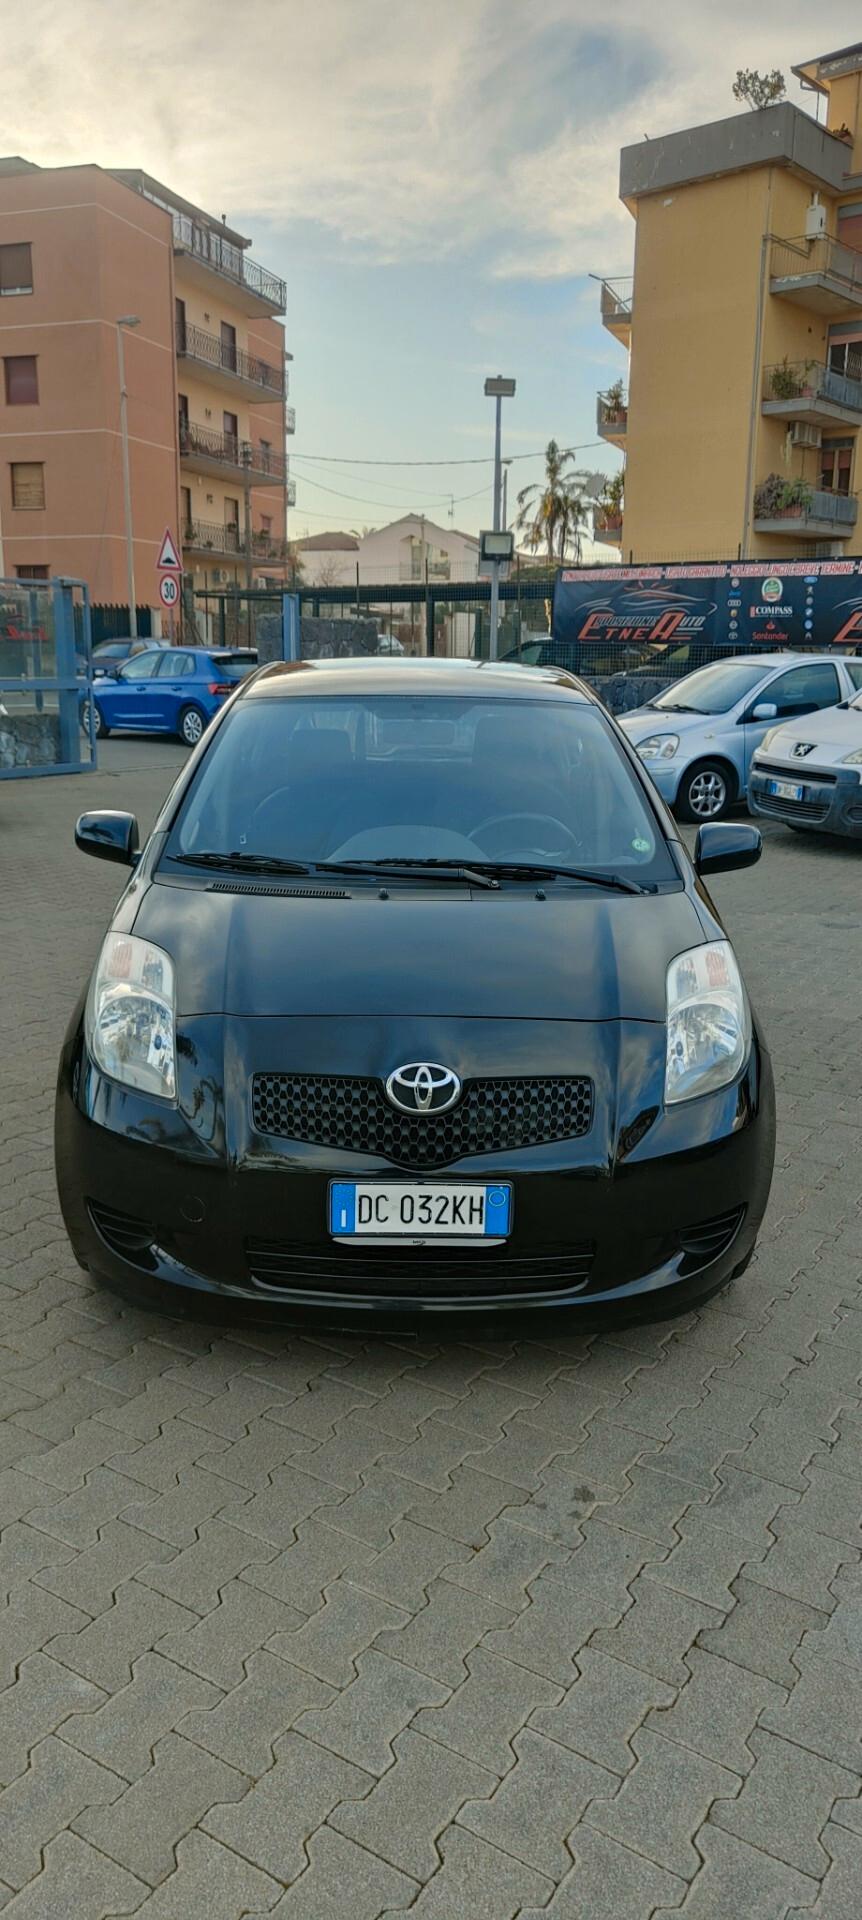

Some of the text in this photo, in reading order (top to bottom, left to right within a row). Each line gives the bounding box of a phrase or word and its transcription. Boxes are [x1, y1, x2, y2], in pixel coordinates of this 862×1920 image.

[164, 582, 175, 599] 30
[756, 606, 793, 614] COMPASS
[752, 631, 788, 640] Santander
[358, 1194, 484, 1225] DC 032KH
